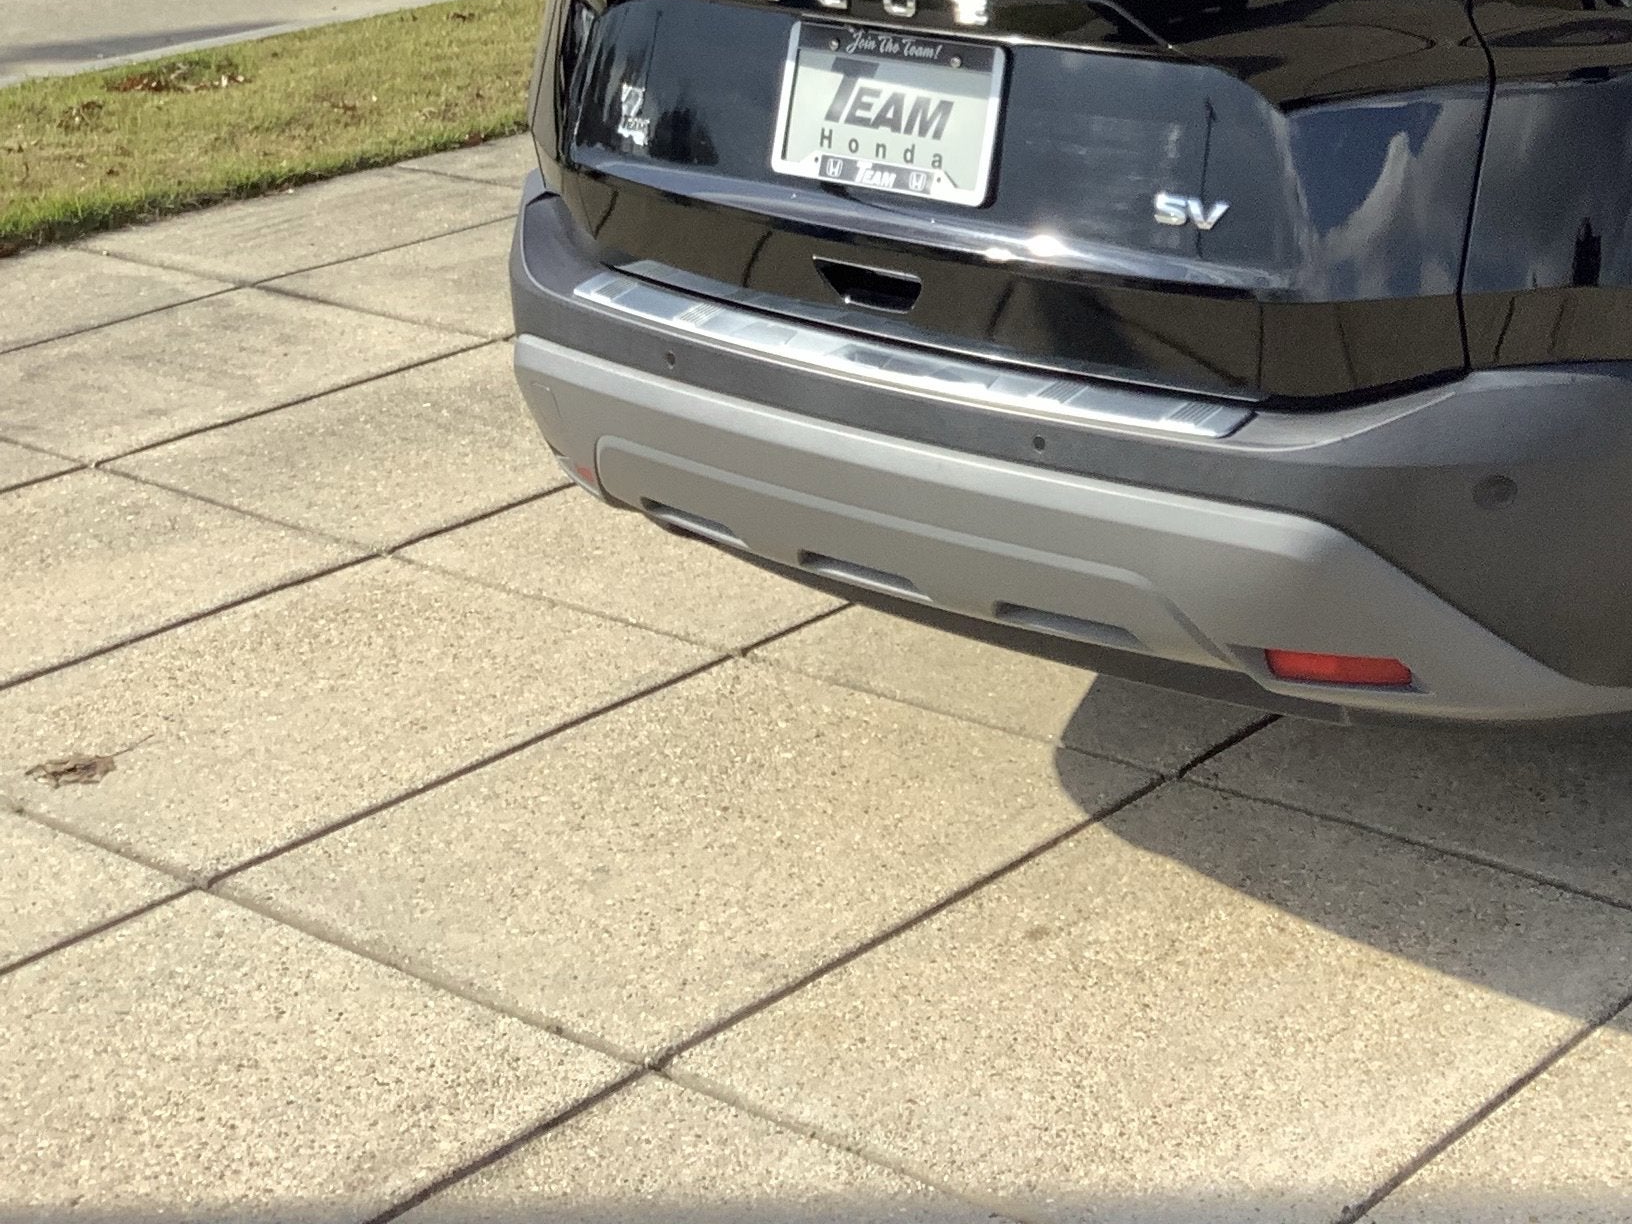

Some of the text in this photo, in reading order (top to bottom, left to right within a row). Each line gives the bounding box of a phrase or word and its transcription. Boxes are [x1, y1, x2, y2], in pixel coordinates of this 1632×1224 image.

[846, 30, 943, 59] Join The Team!
[824, 57, 955, 141] TEAM
[819, 128, 944, 170] Honda
[855, 161, 897, 188] TEAM
[1154, 192, 1230, 230] SV
